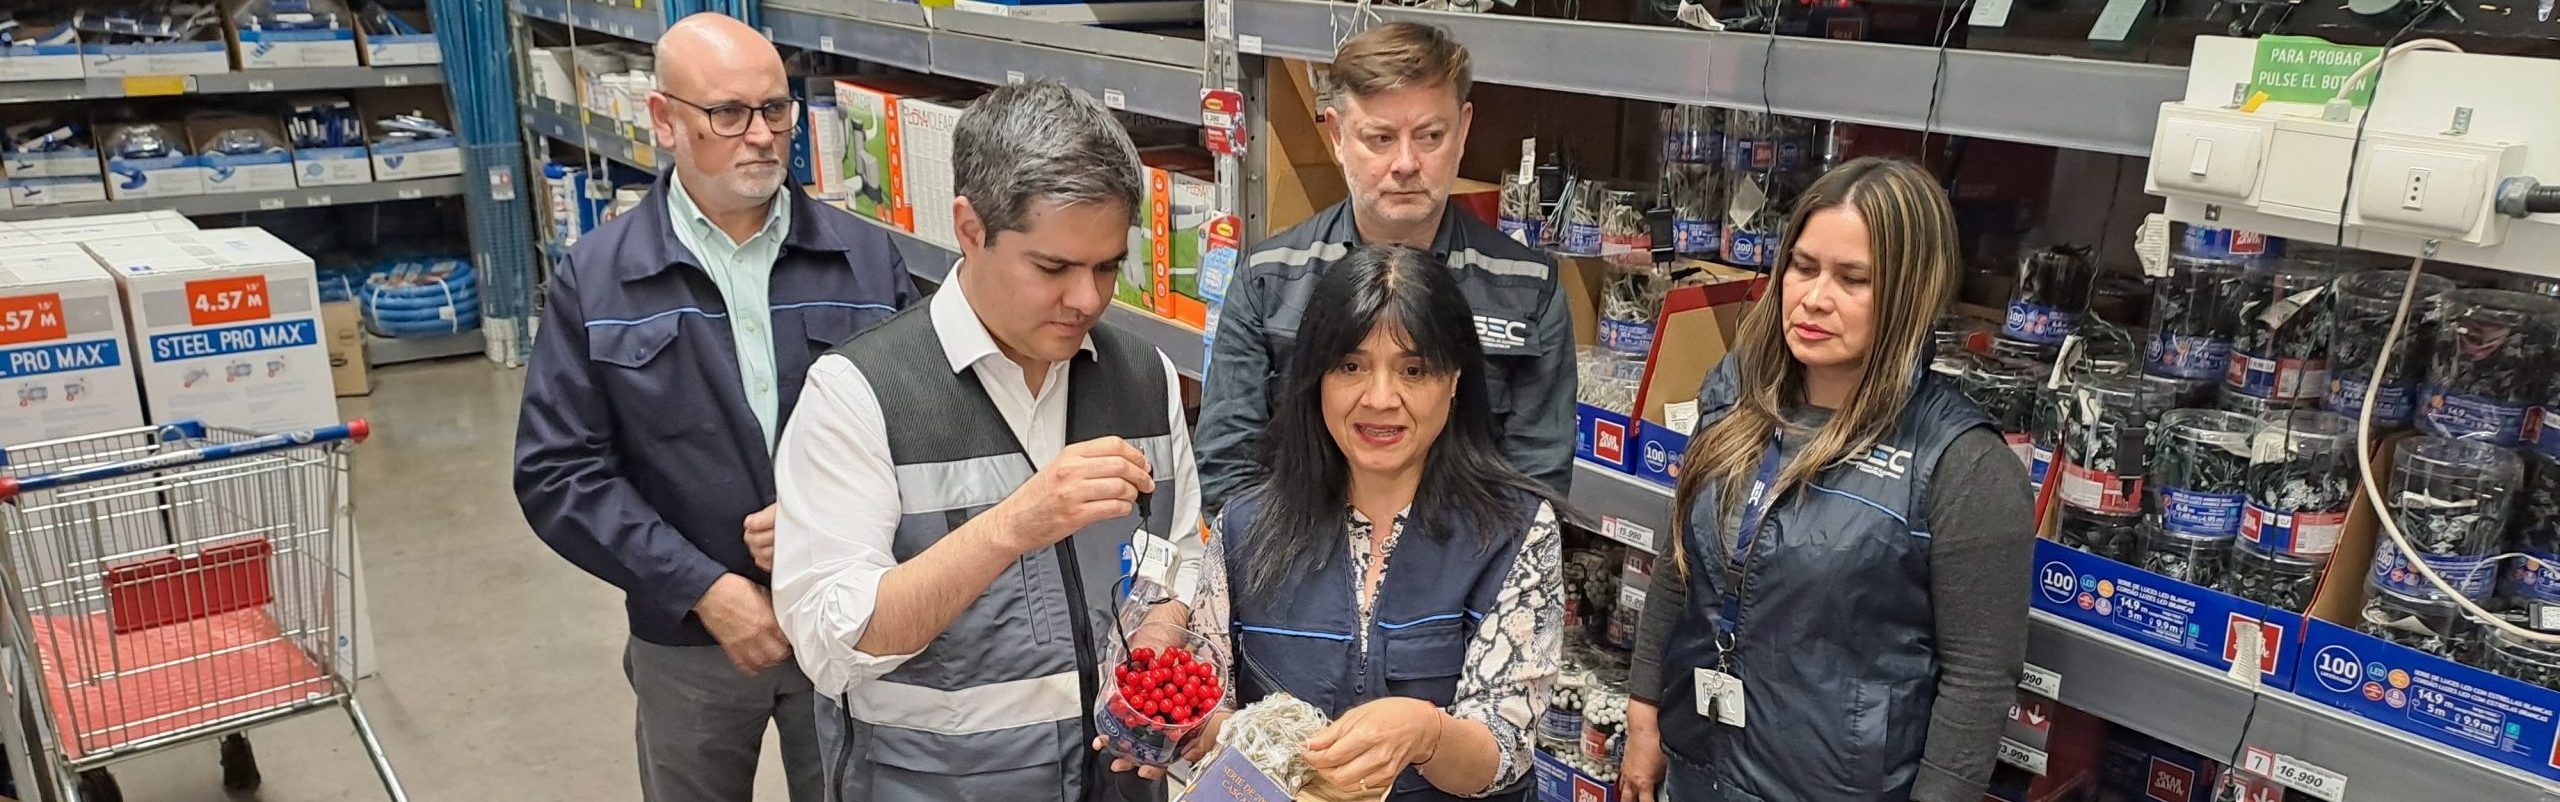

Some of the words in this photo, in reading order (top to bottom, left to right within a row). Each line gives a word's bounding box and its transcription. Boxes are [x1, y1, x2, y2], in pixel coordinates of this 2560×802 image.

[2270, 48, 2304, 64] PARA
[2308, 50, 2362, 66] PROBAR
[2258, 71, 2298, 87] PULSE
[2302, 74, 2316, 89] EL
[2321, 75, 2366, 91] BOTN
[195, 290, 244, 312] 4.57
[247, 293, 263, 308] M
[40, 313, 57, 328] M
[2009, 309, 2024, 322] 100
[157, 334, 217, 360] STEEL
[220, 329, 256, 351] PRO
[260, 324, 304, 347] MAX
[11, 351, 51, 374] PRO
[57, 347, 105, 369] MAX
[1646, 446, 1664, 463] 100
[2044, 568, 2074, 591] 100
[2081, 577, 2095, 587] LED
[2119, 596, 2140, 610] 14.9
[2158, 590, 2170, 598] LED
[2319, 653, 2358, 679] 100
[2369, 665, 2385, 677] LED
[2460, 683, 2473, 692] LED
[2418, 688, 2444, 704] 14.9
[2443, 700, 2454, 709] m
[1222, 765, 1245, 785] SERIE
[2157, 770, 2182, 785] DEAR
[2254, 755, 2263, 770] 7
[2279, 764, 2323, 788] 16.990
[2154, 778, 2184, 797] SANTA
